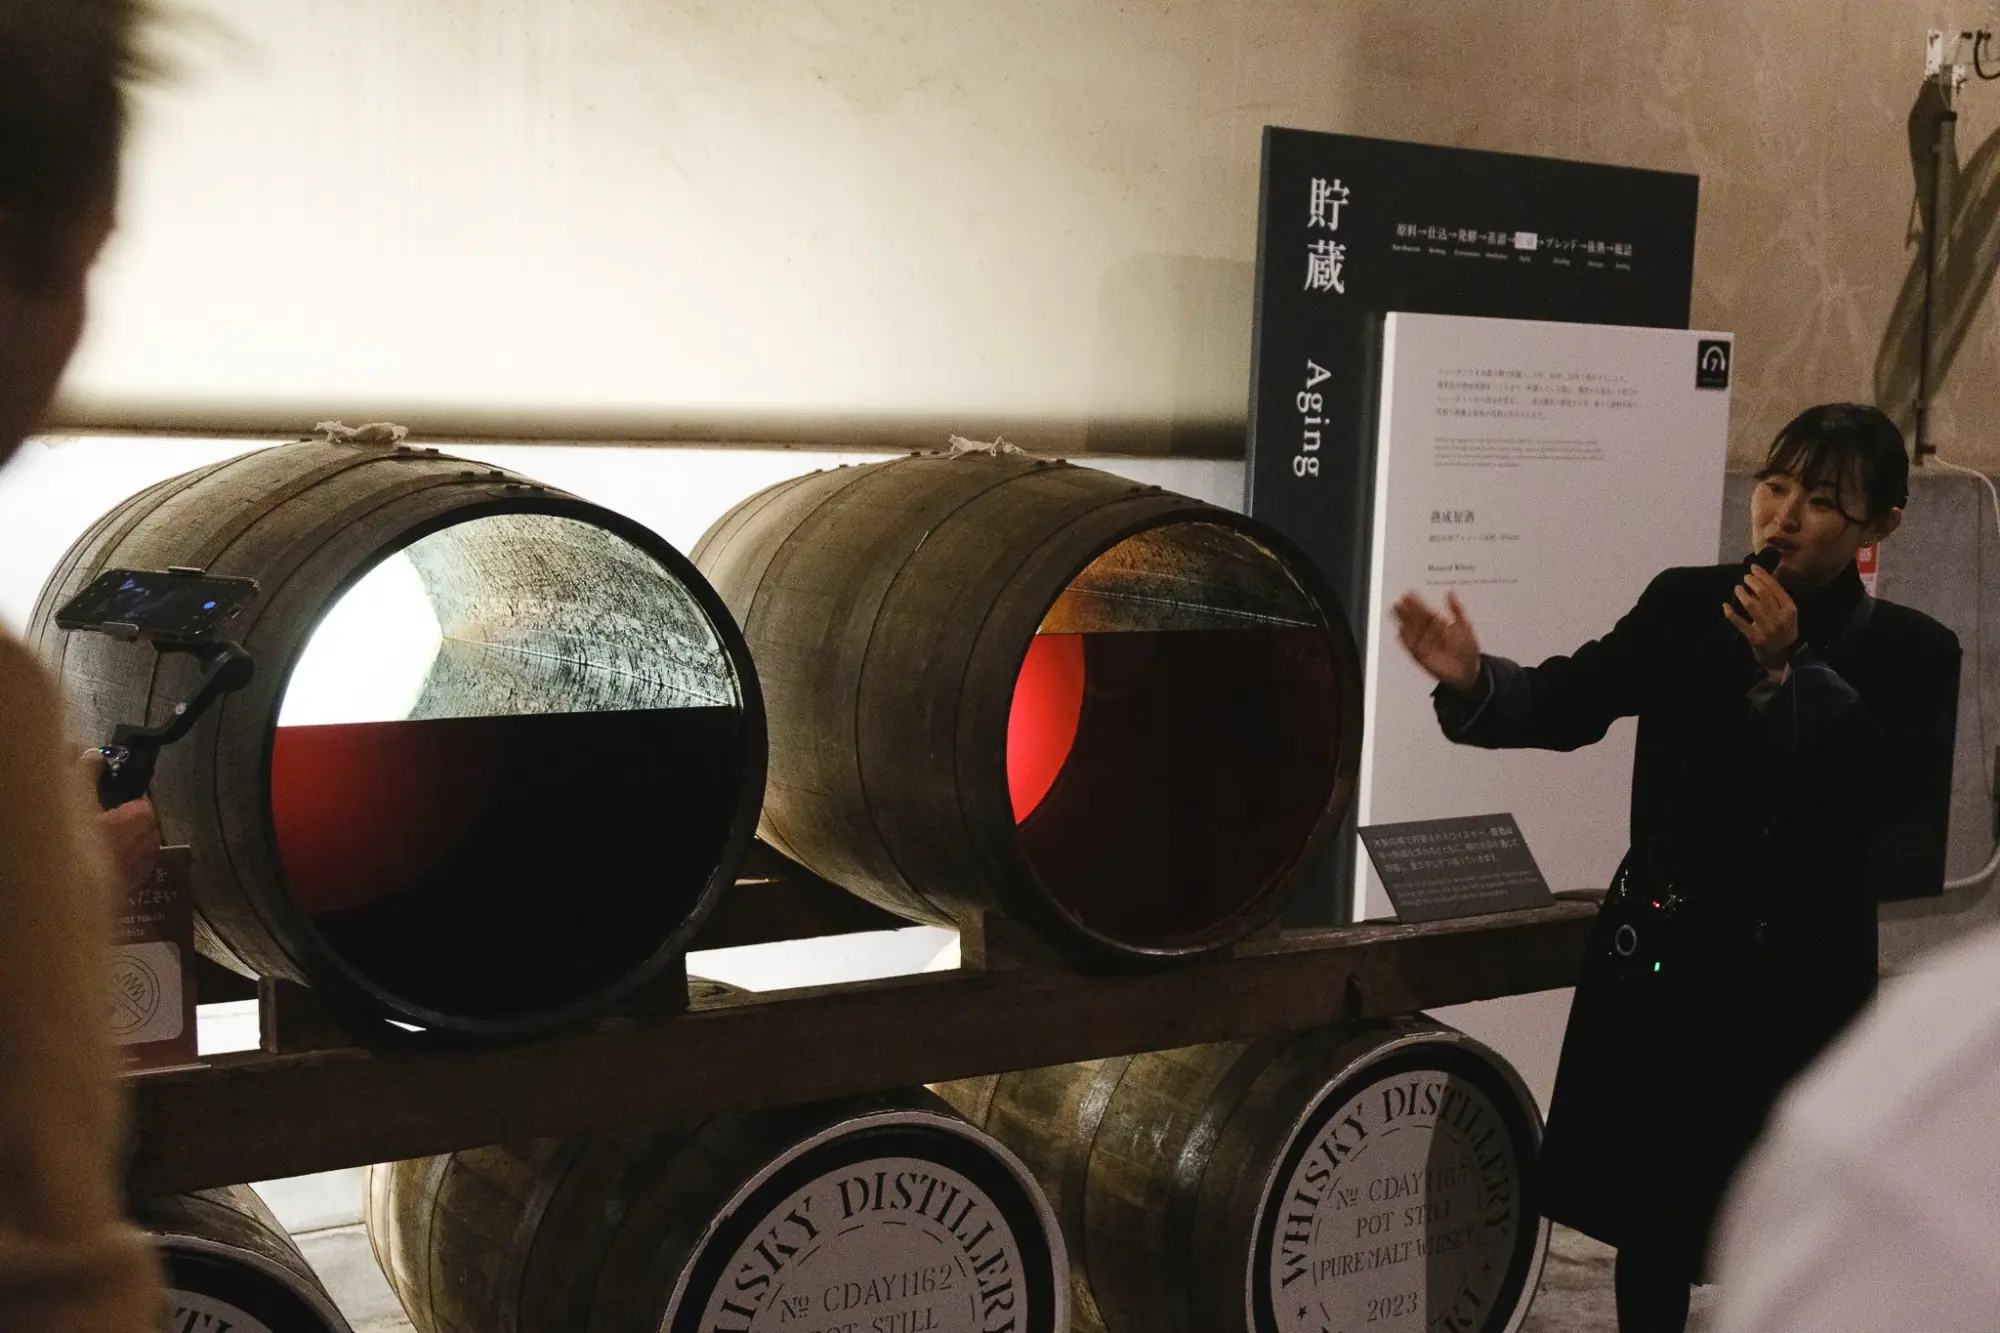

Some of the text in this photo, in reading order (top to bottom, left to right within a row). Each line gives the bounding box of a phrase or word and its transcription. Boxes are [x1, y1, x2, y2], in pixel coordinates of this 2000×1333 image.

[1304, 177, 1351, 295] 貯蔵
[1293, 360, 1333, 478] Aging
[1281, 1102, 1370, 1289] WHISKY
[1356, 1212, 1396, 1238] POT
[713, 1196, 821, 1333] ISKY
[1319, 1254, 1364, 1281] PURE
[1366, 1240, 1415, 1269] MALT
[822, 1262, 953, 1312] CDAY1162
[1366, 1291, 1419, 1323] 2023
[871, 1307, 939, 1333] STILL
